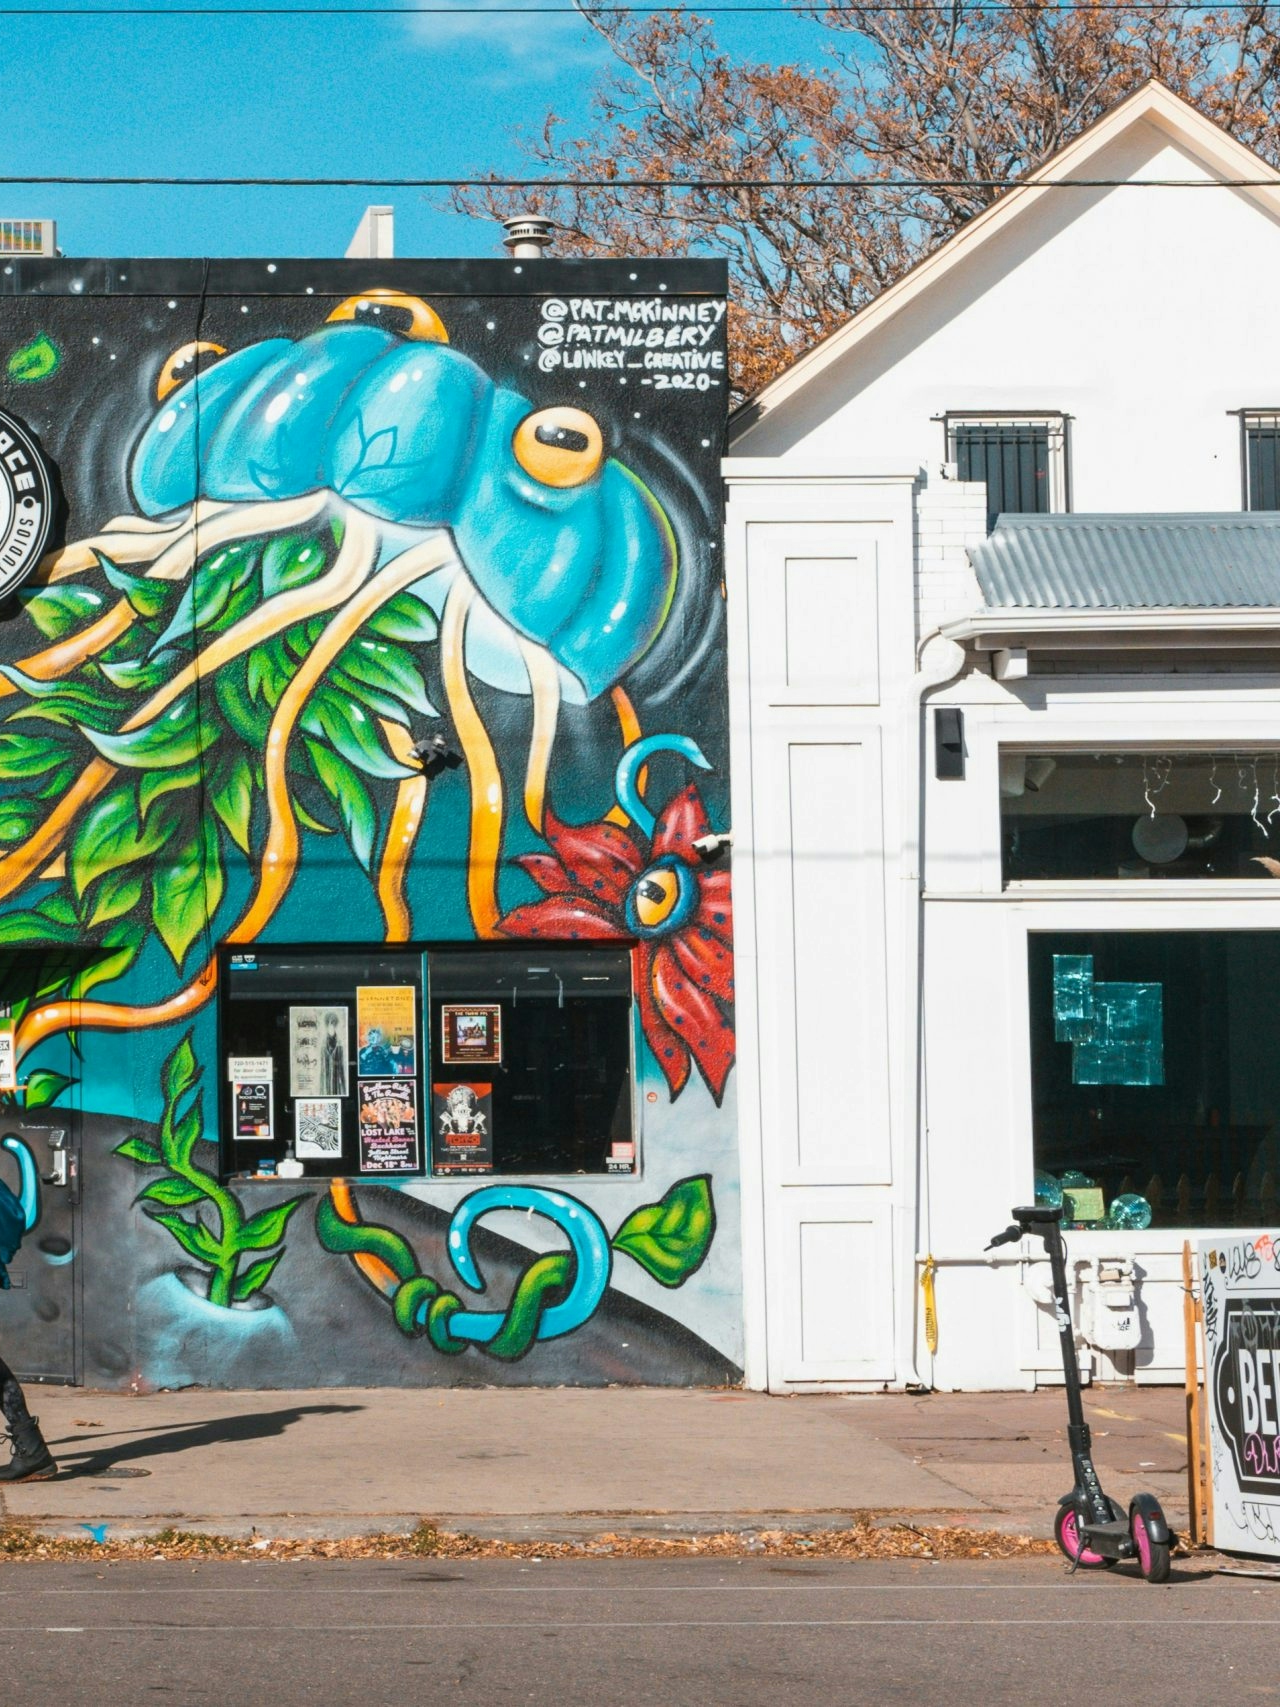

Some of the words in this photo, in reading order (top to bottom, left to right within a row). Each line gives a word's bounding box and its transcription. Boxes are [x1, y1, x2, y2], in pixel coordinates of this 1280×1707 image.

[537, 322, 716, 348] @PATMILBERY
[641, 373, 720, 391] -2020-
[361, 1129, 382, 1137] LOST
[384, 1128, 405, 1136] LAKE
